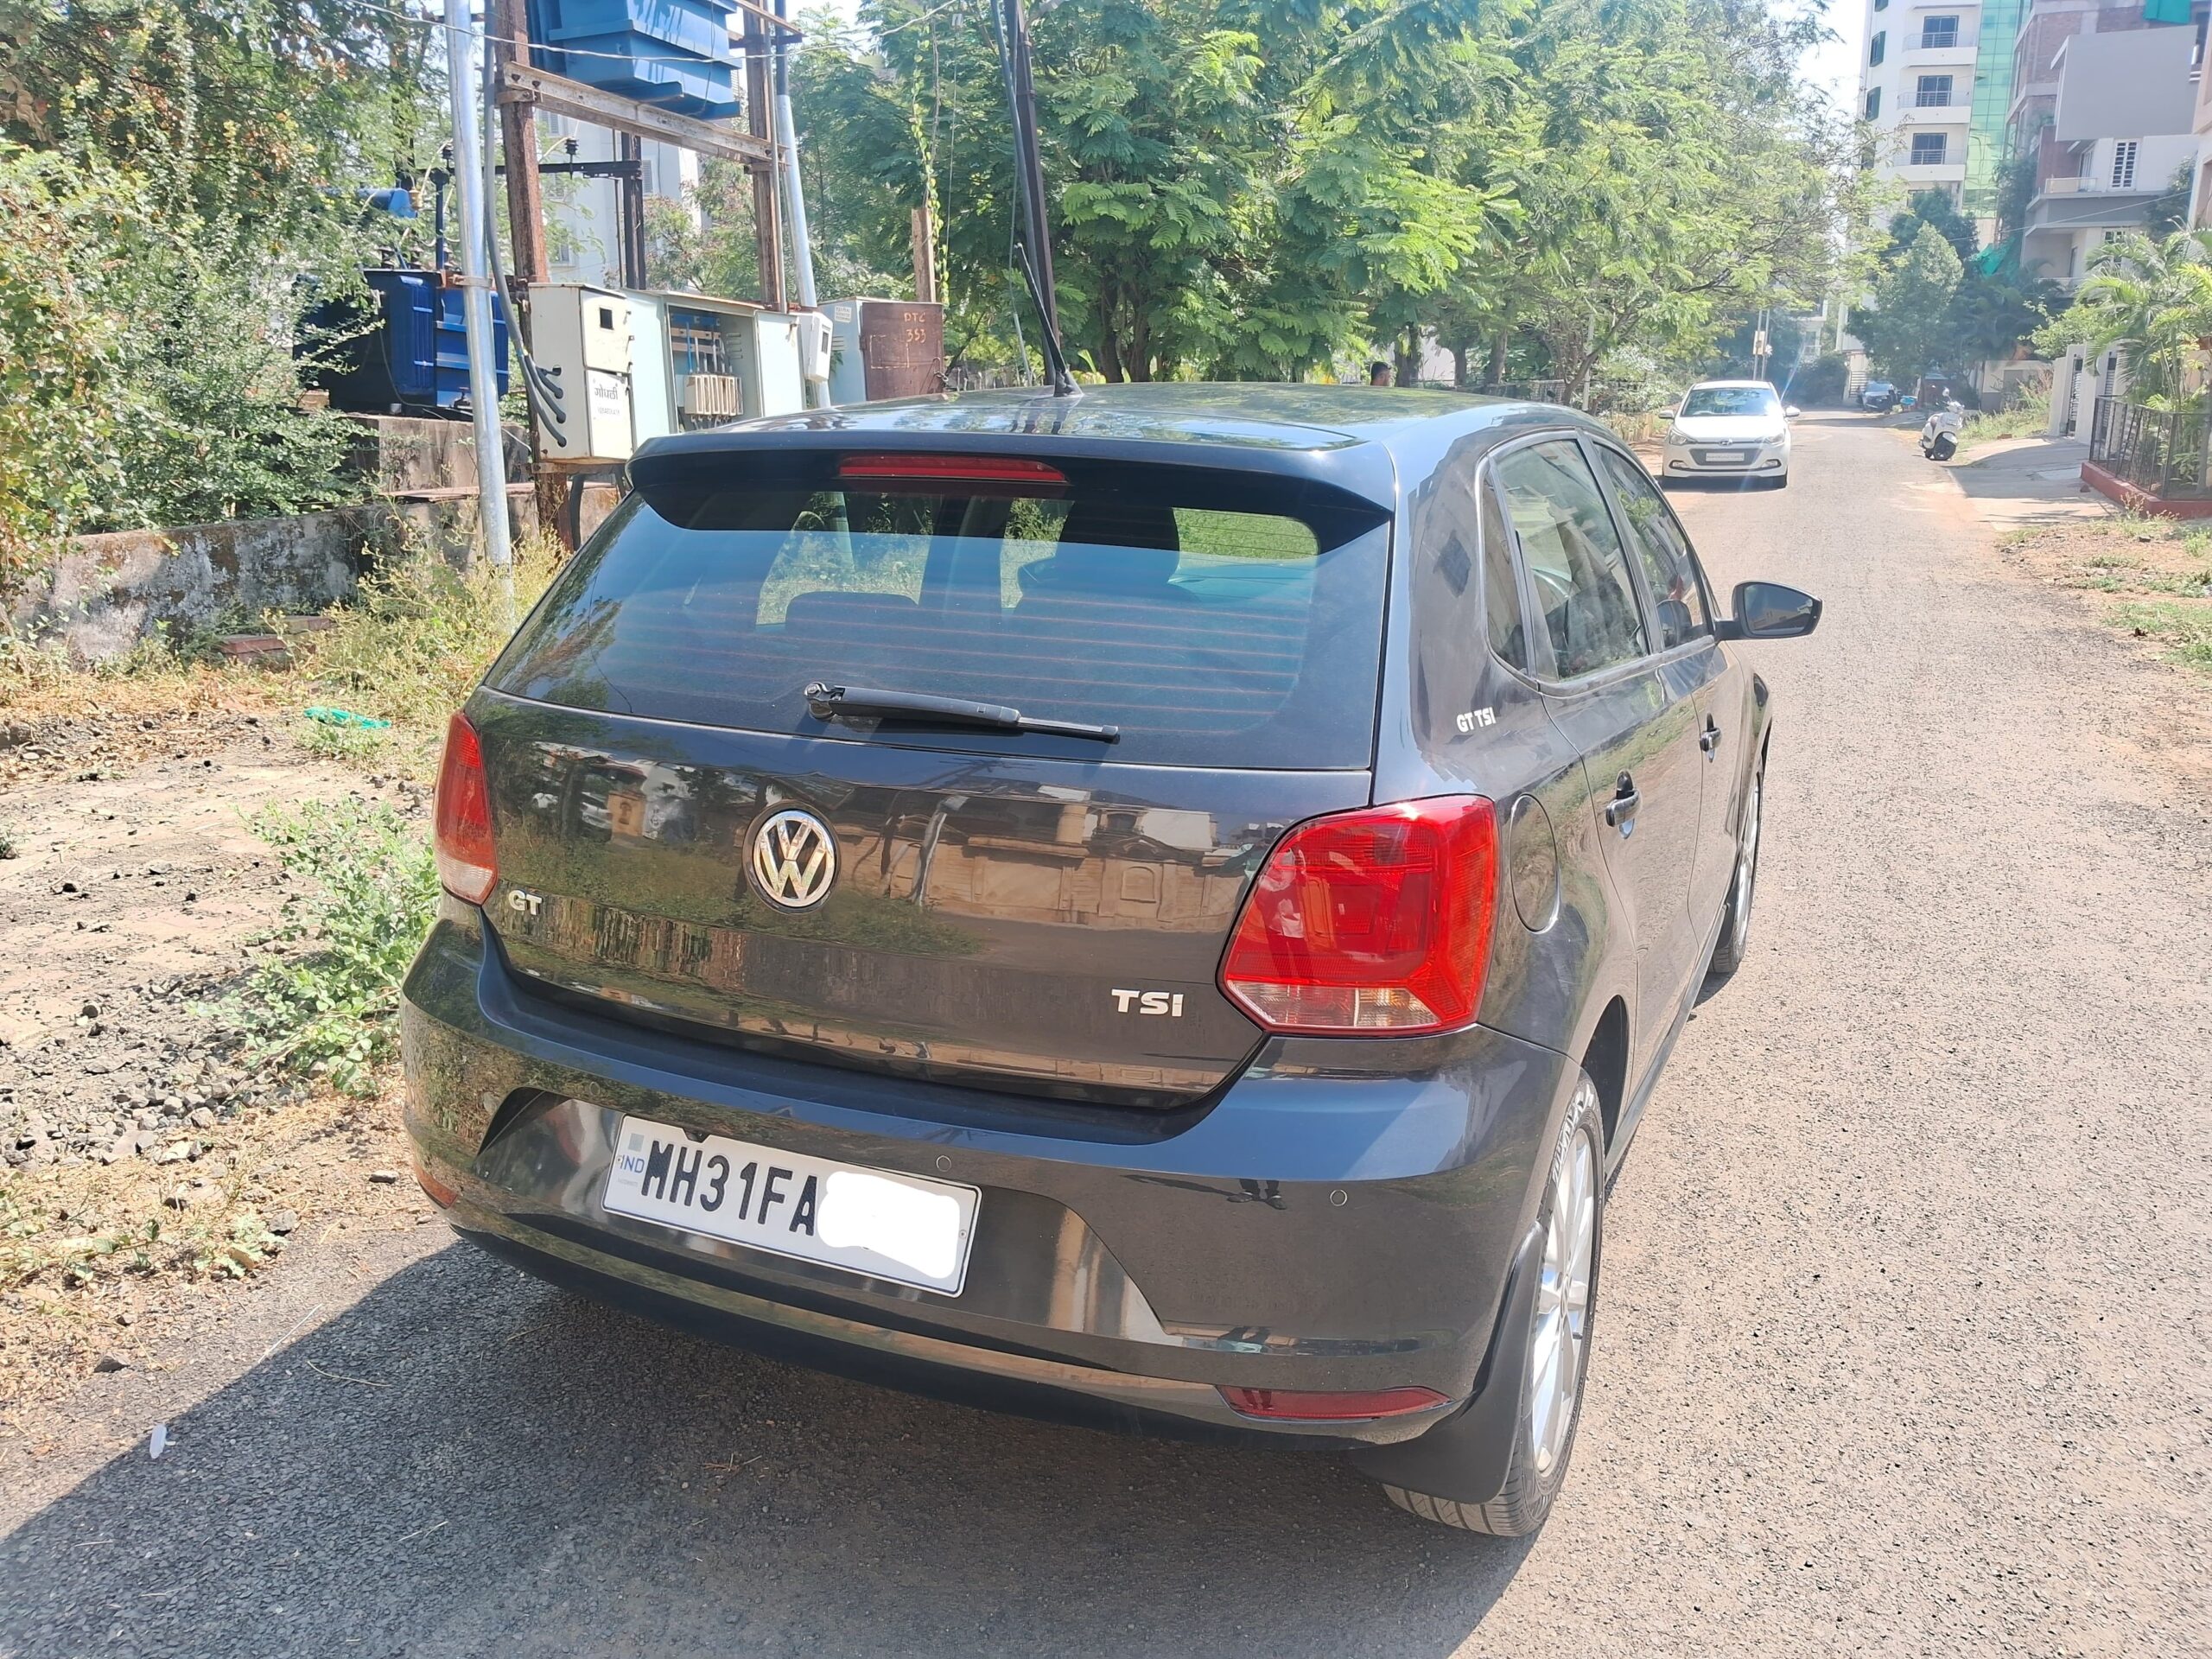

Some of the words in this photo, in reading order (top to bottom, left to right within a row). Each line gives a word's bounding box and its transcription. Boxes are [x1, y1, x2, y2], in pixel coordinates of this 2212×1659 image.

[1456, 712, 1474, 733] GT
[1473, 706, 1496, 728] TSI
[508, 889, 543, 916] GT
[1110, 988, 1184, 1017] TSI
[620, 1154, 645, 1173] IND
